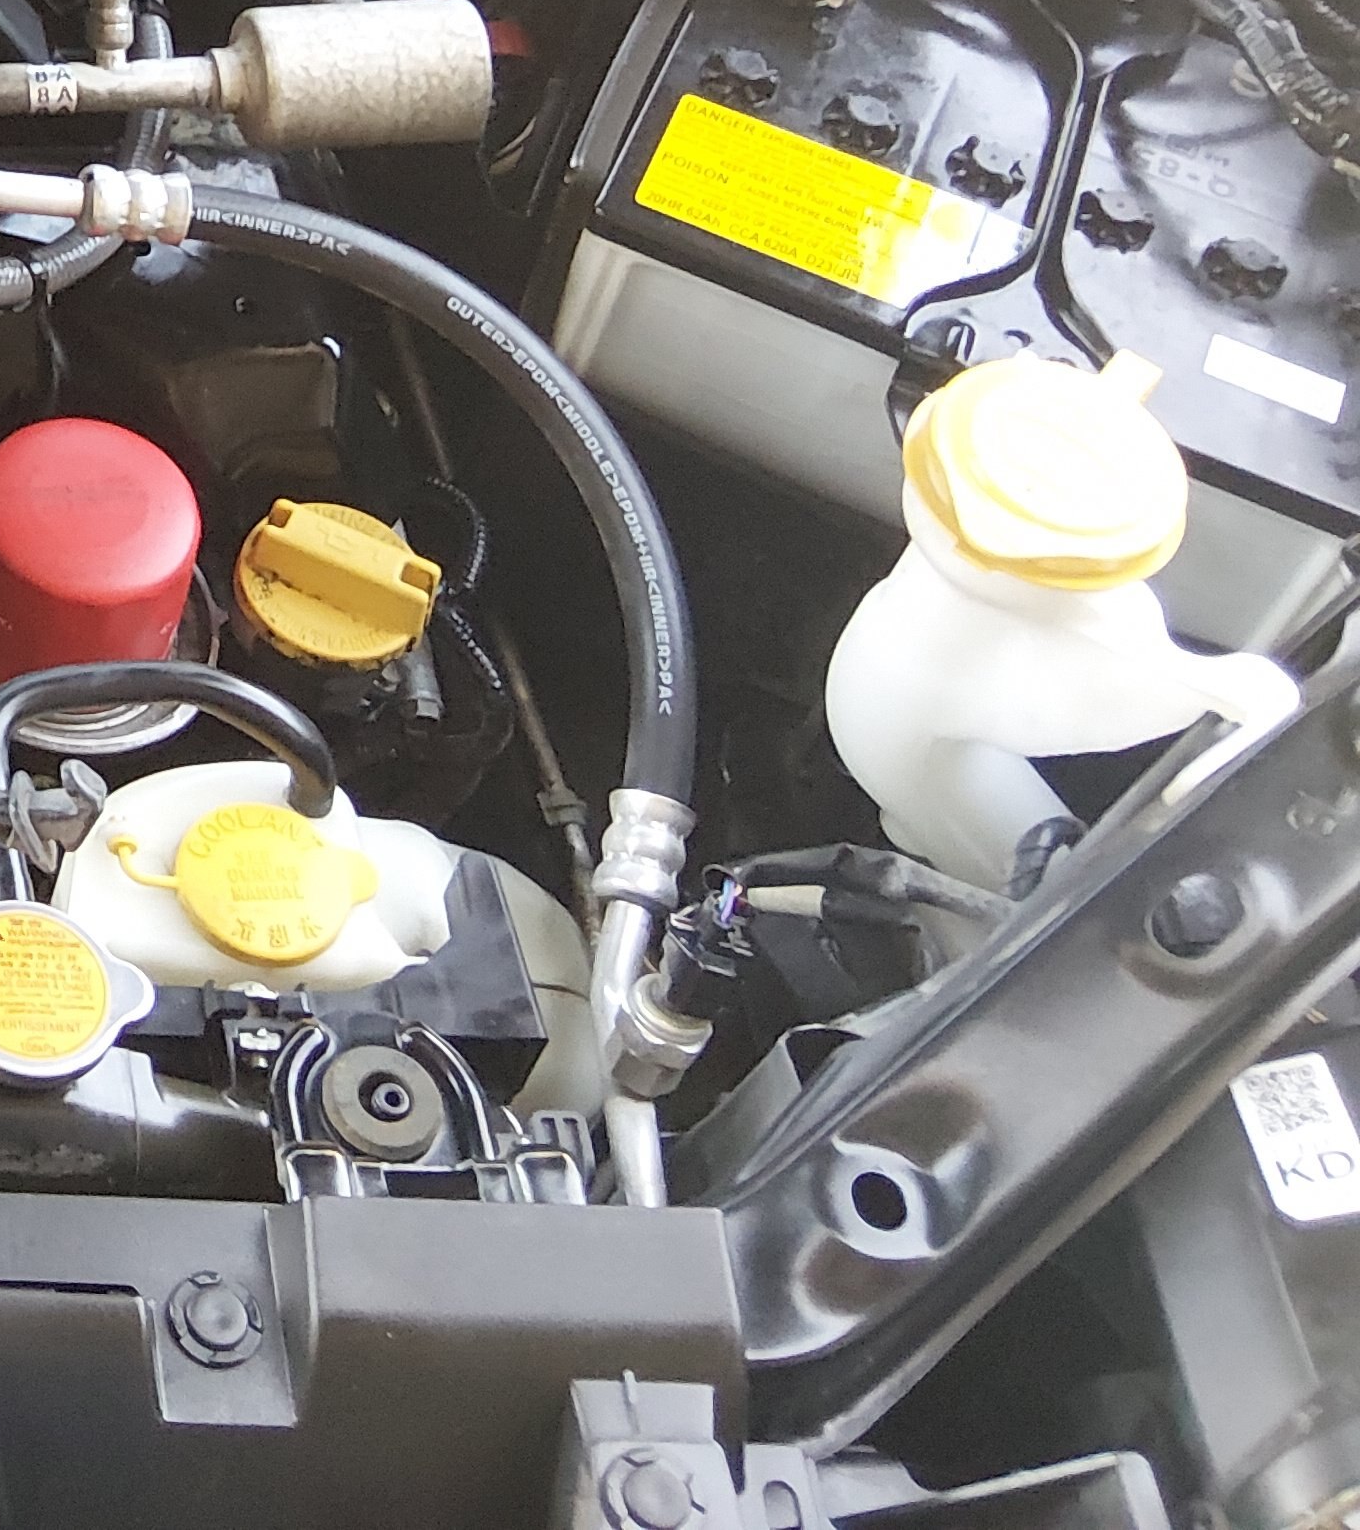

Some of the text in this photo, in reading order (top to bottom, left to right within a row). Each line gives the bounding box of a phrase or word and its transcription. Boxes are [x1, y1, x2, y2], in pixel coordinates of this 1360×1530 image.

[684, 99, 757, 138] DANGER
[661, 149, 731, 186] POISON
[727, 221, 762, 245] CCA
[762, 235, 800, 260] 620A
[230, 884, 305, 902] MANUAL
[1275, 1150, 1356, 1188] KD
